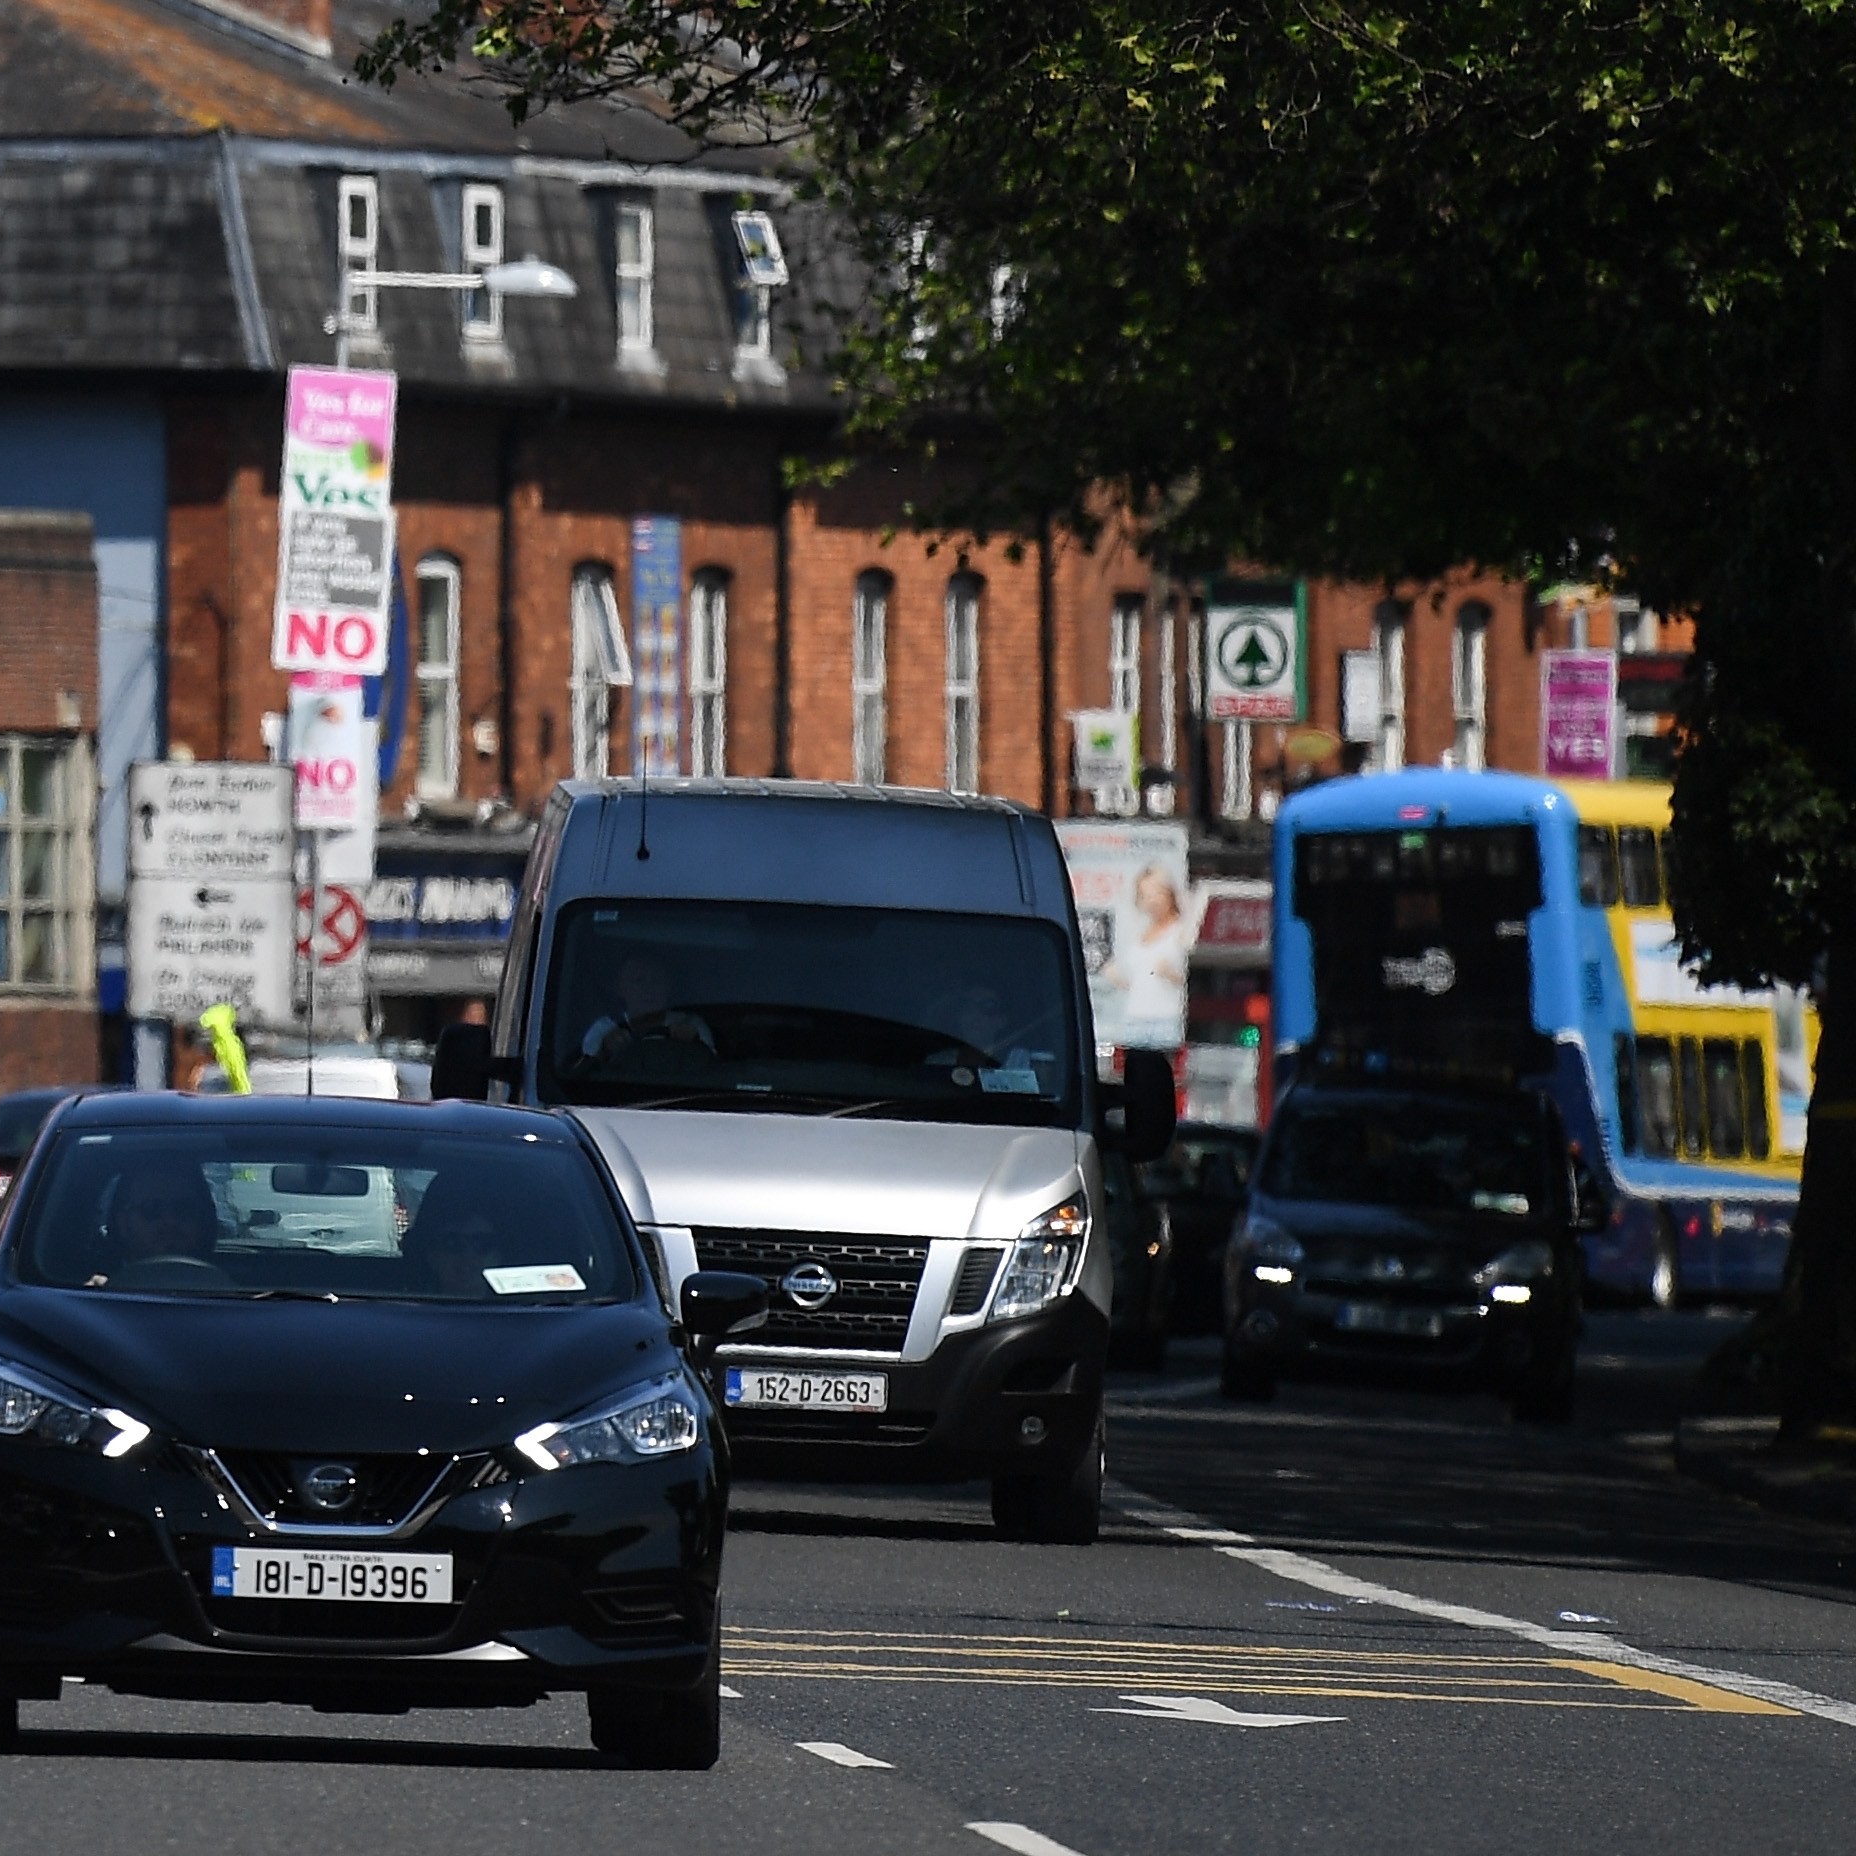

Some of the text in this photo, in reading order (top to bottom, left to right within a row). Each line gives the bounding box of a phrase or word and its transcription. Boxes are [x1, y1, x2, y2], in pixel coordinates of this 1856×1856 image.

[286, 613, 376, 661] NO
[1549, 737, 1607, 762] YES
[296, 759, 358, 794] NO
[757, 1376, 871, 1404] 152-D-2663
[255, 1559, 428, 1600] 181-D-19396
